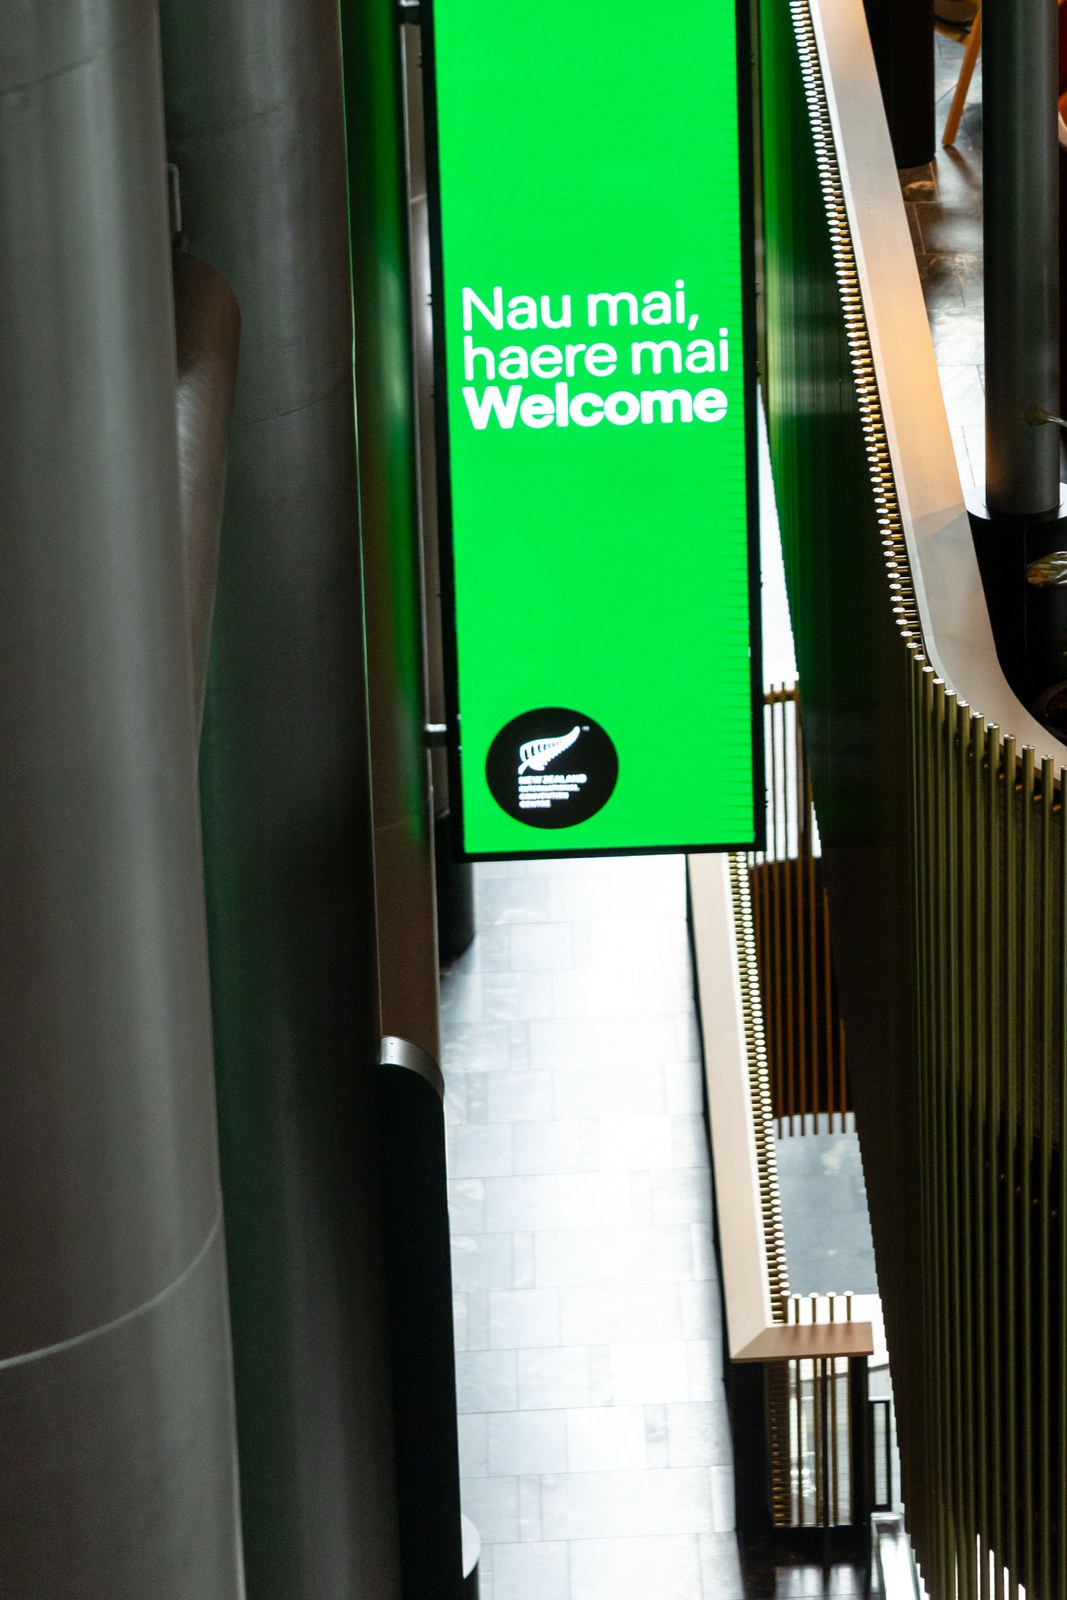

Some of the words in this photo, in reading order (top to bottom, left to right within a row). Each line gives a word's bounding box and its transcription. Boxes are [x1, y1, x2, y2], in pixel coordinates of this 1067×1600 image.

[462, 286, 572, 332] Nau
[587, 279, 699, 331] mai,
[463, 335, 618, 381] haere
[631, 327, 729, 375] mai
[461, 381, 729, 430] Welcome
